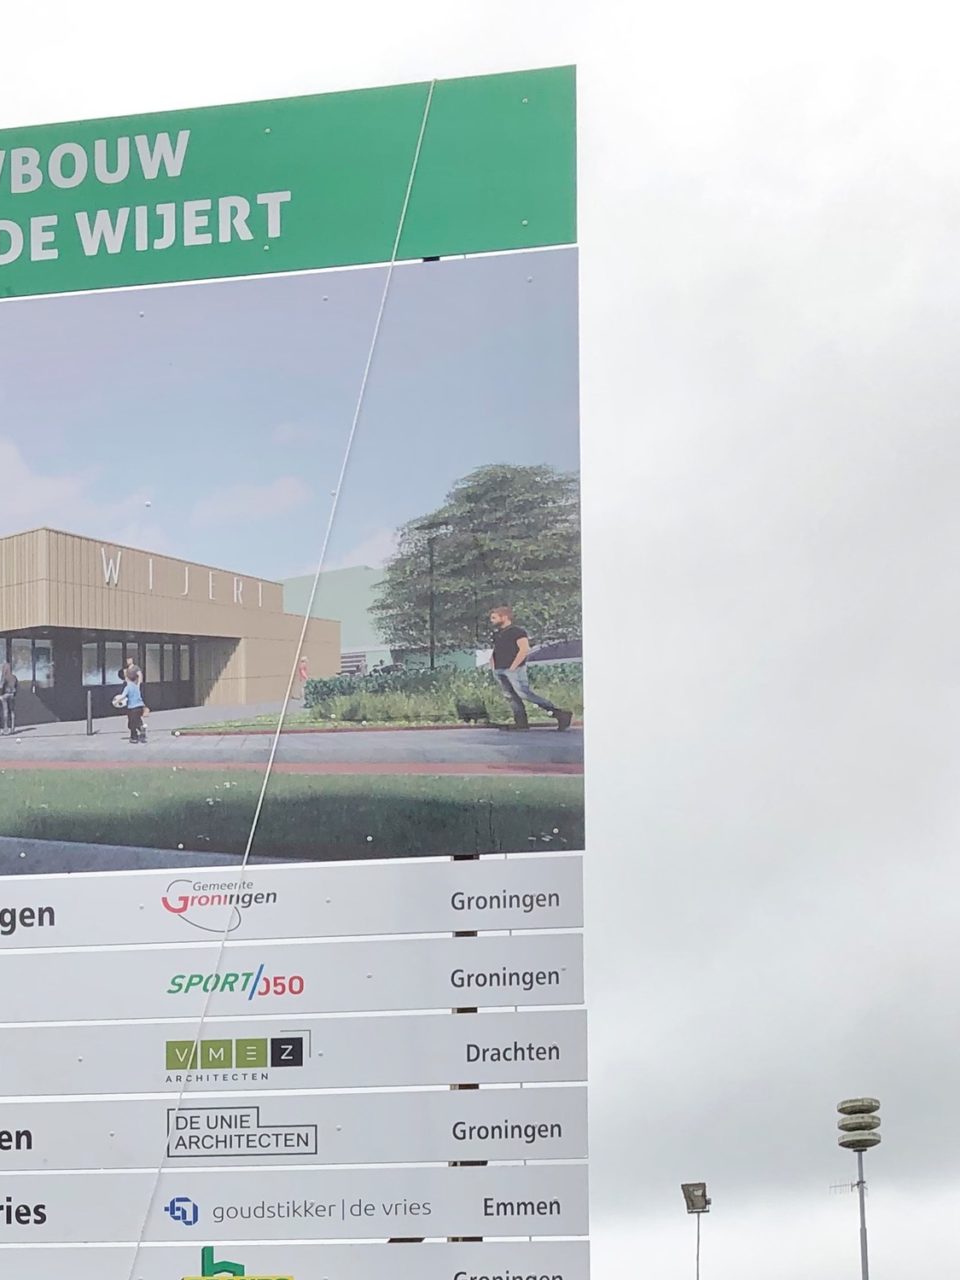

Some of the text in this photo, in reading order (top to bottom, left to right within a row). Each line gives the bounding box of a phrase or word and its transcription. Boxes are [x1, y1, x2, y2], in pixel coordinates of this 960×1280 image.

[74, 190, 292, 257] WIJERT
[192, 881, 254, 892] Gemeente
[161, 891, 278, 914] Groningen
[451, 889, 560, 913] Groningen
[450, 967, 560, 991] Groningen
[466, 1041, 560, 1063] Drachten
[166, 1073, 269, 1083] ARCHITECTEN
[175, 1114, 251, 1130] DE UNIE
[452, 1119, 563, 1144] Groningen
[175, 1133, 309, 1149] ARCHITECTEN
[382, 1199, 433, 1216] vries
[483, 1197, 561, 1217] Emmen
